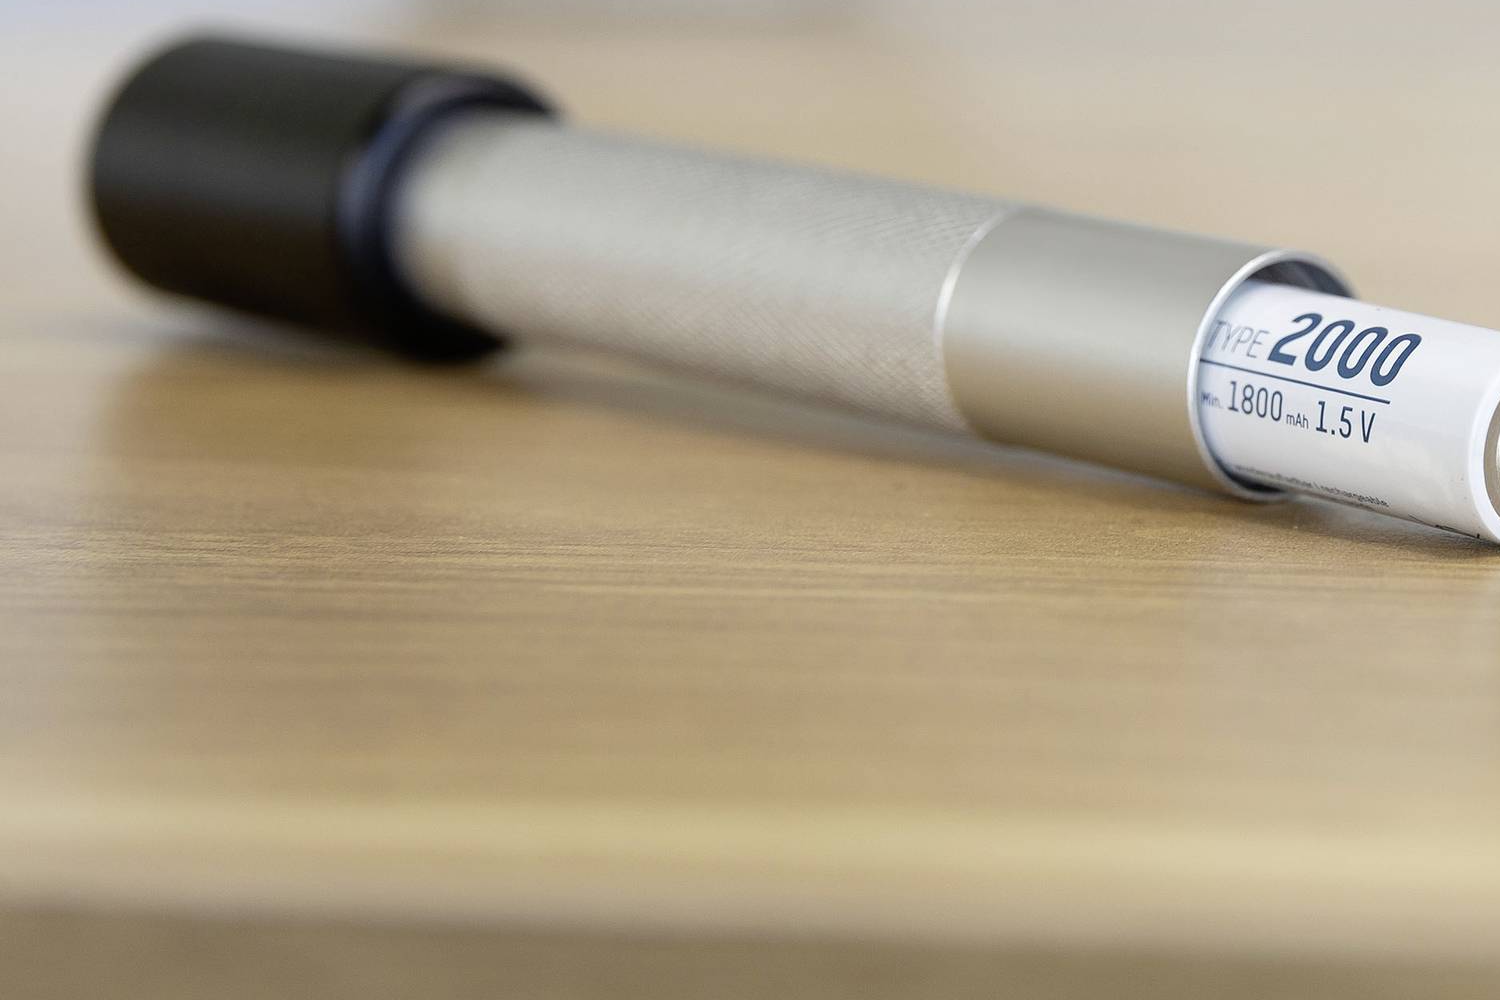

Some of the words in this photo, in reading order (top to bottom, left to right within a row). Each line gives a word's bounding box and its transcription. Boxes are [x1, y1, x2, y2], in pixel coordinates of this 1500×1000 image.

[1207, 320, 1269, 359] TYPE
[1267, 313, 1423, 387] 2000
[1227, 380, 1284, 422] 1800
[1286, 412, 1309, 430] mAh
[1315, 400, 1354, 439] 1.5
[1361, 409, 1377, 444] V
